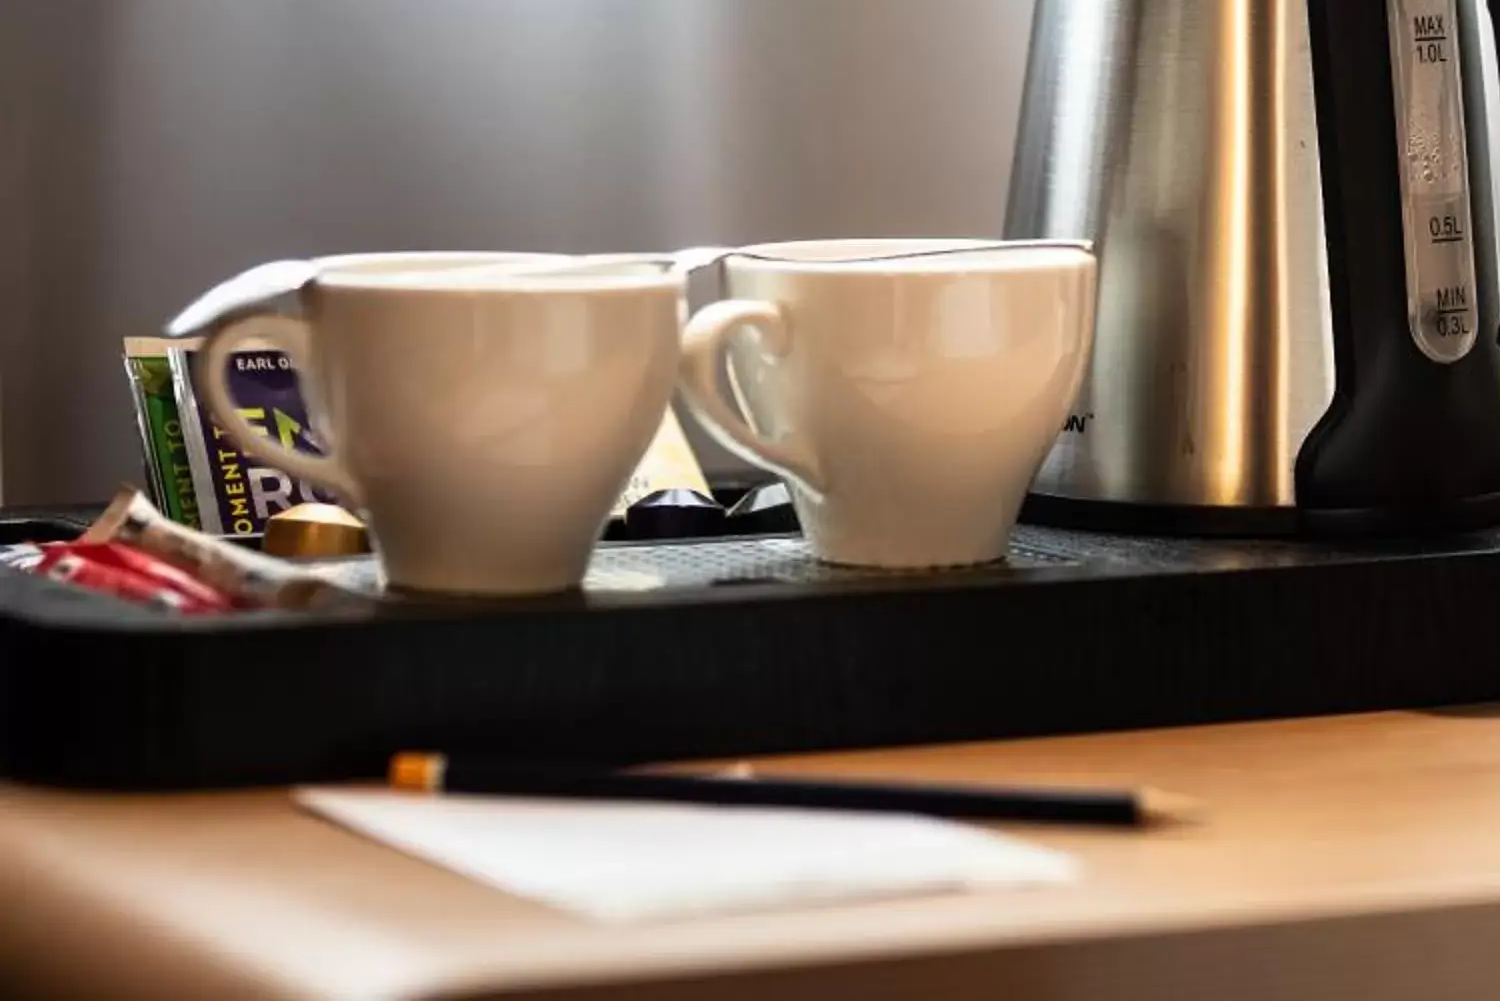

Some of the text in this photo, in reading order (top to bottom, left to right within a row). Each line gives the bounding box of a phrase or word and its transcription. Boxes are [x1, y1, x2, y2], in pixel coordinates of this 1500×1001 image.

[1414, 14, 1445, 36] MAX
[1416, 43, 1447, 63] 1.0L
[1429, 216, 1462, 236] 0.5L
[1437, 287, 1465, 307] MIN
[1437, 316, 1469, 336] 0.3L
[236, 357, 276, 371] EARL
